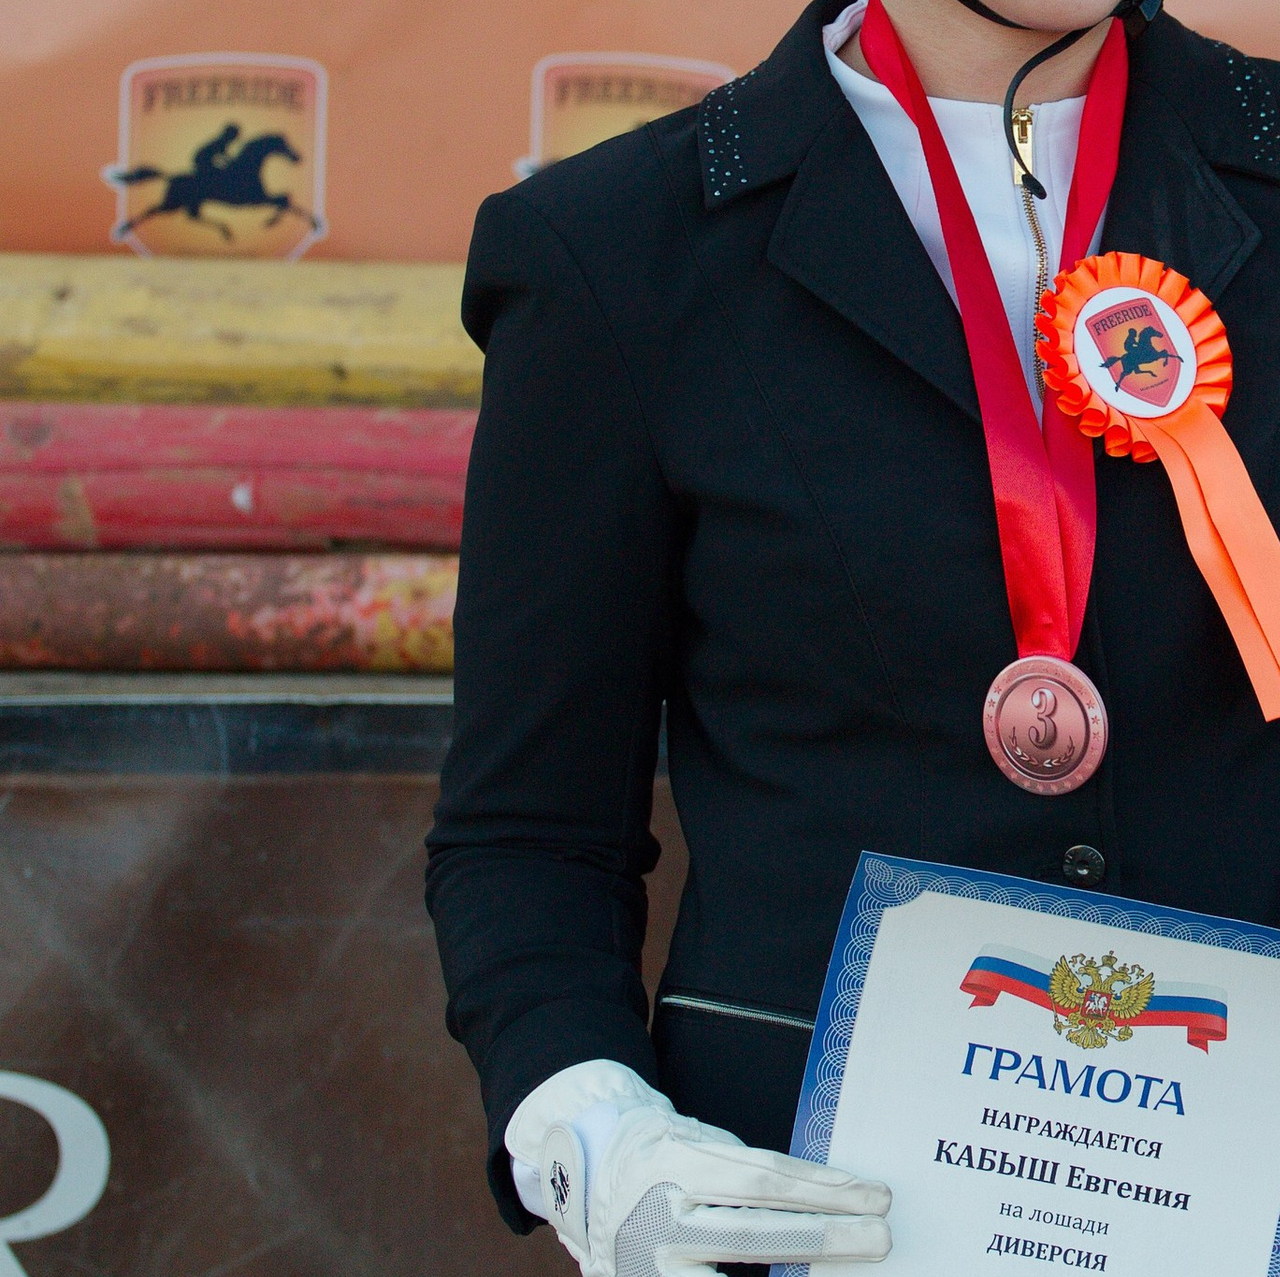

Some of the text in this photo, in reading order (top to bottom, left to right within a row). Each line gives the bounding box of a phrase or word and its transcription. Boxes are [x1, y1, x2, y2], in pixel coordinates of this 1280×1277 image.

[143, 76, 305, 114] FREERIDE
[1093, 304, 1152, 336] FREERIDE
[1029, 686, 1060, 749] 3
[961, 1042, 1185, 1116] ГРАМОТА
[981, 1108, 1163, 1159] НАГРАЖДАЕТСЯ
[934, 1139, 1191, 1211] КАБЫШ Евгения
[999, 1202, 1110, 1236] на лошади
[986, 1233, 1108, 1272] ДИВЕРСИЯ
